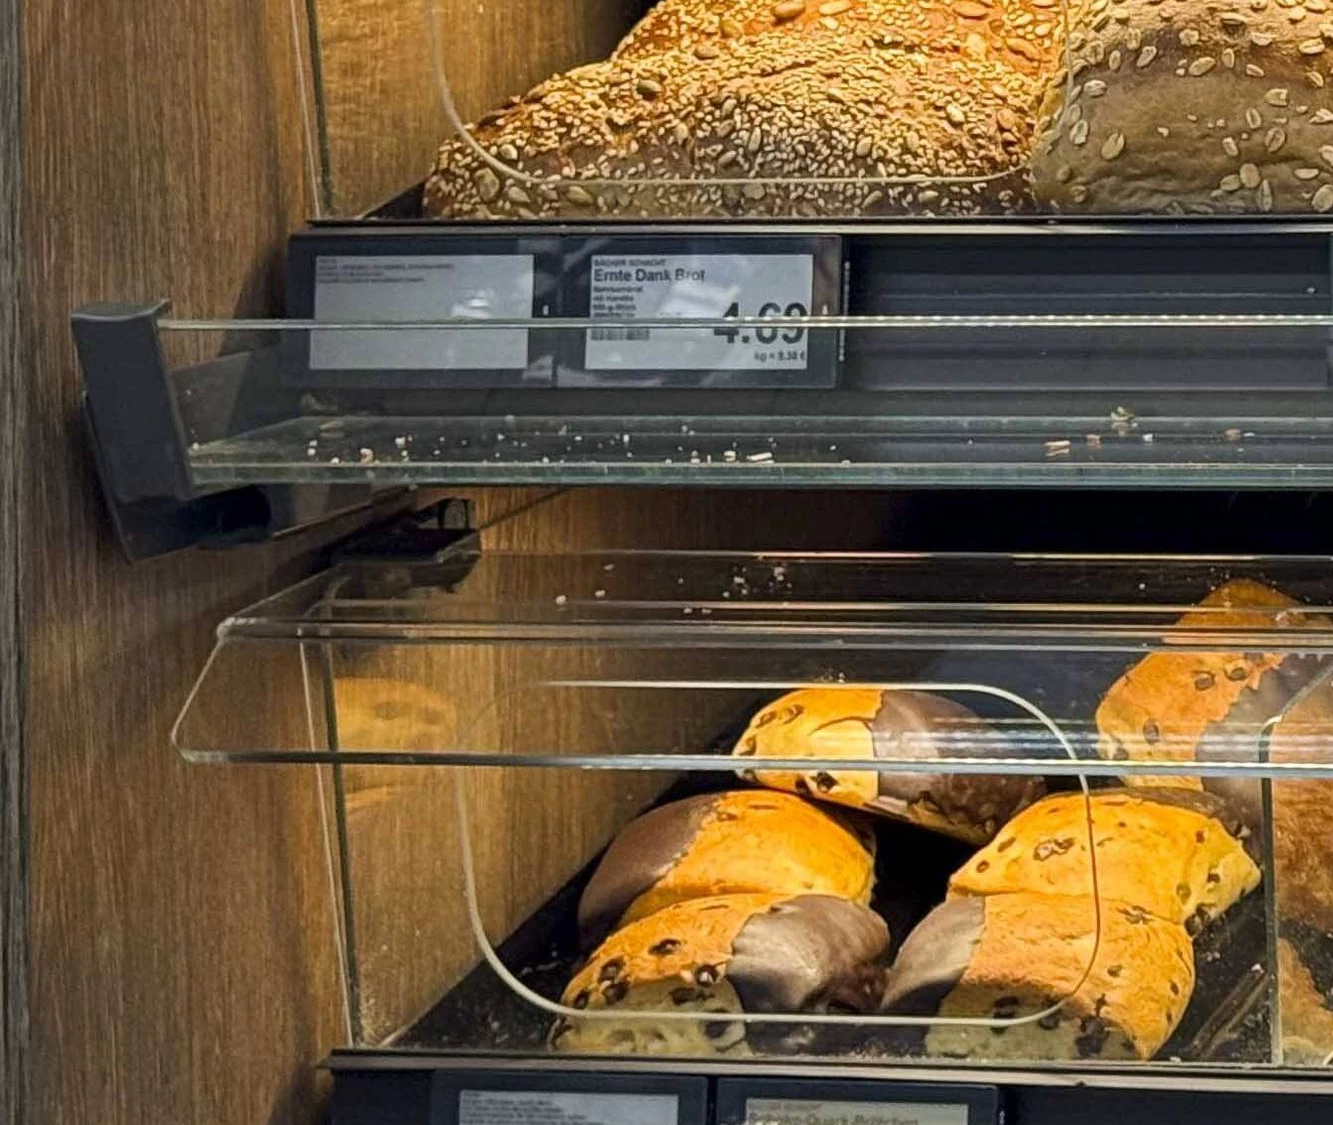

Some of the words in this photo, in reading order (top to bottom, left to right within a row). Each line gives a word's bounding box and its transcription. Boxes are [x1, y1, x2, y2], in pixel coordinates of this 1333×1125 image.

[594, 269, 632, 282] Ernte
[635, 269, 670, 281] Dank
[713, 302, 807, 344] 4.69
